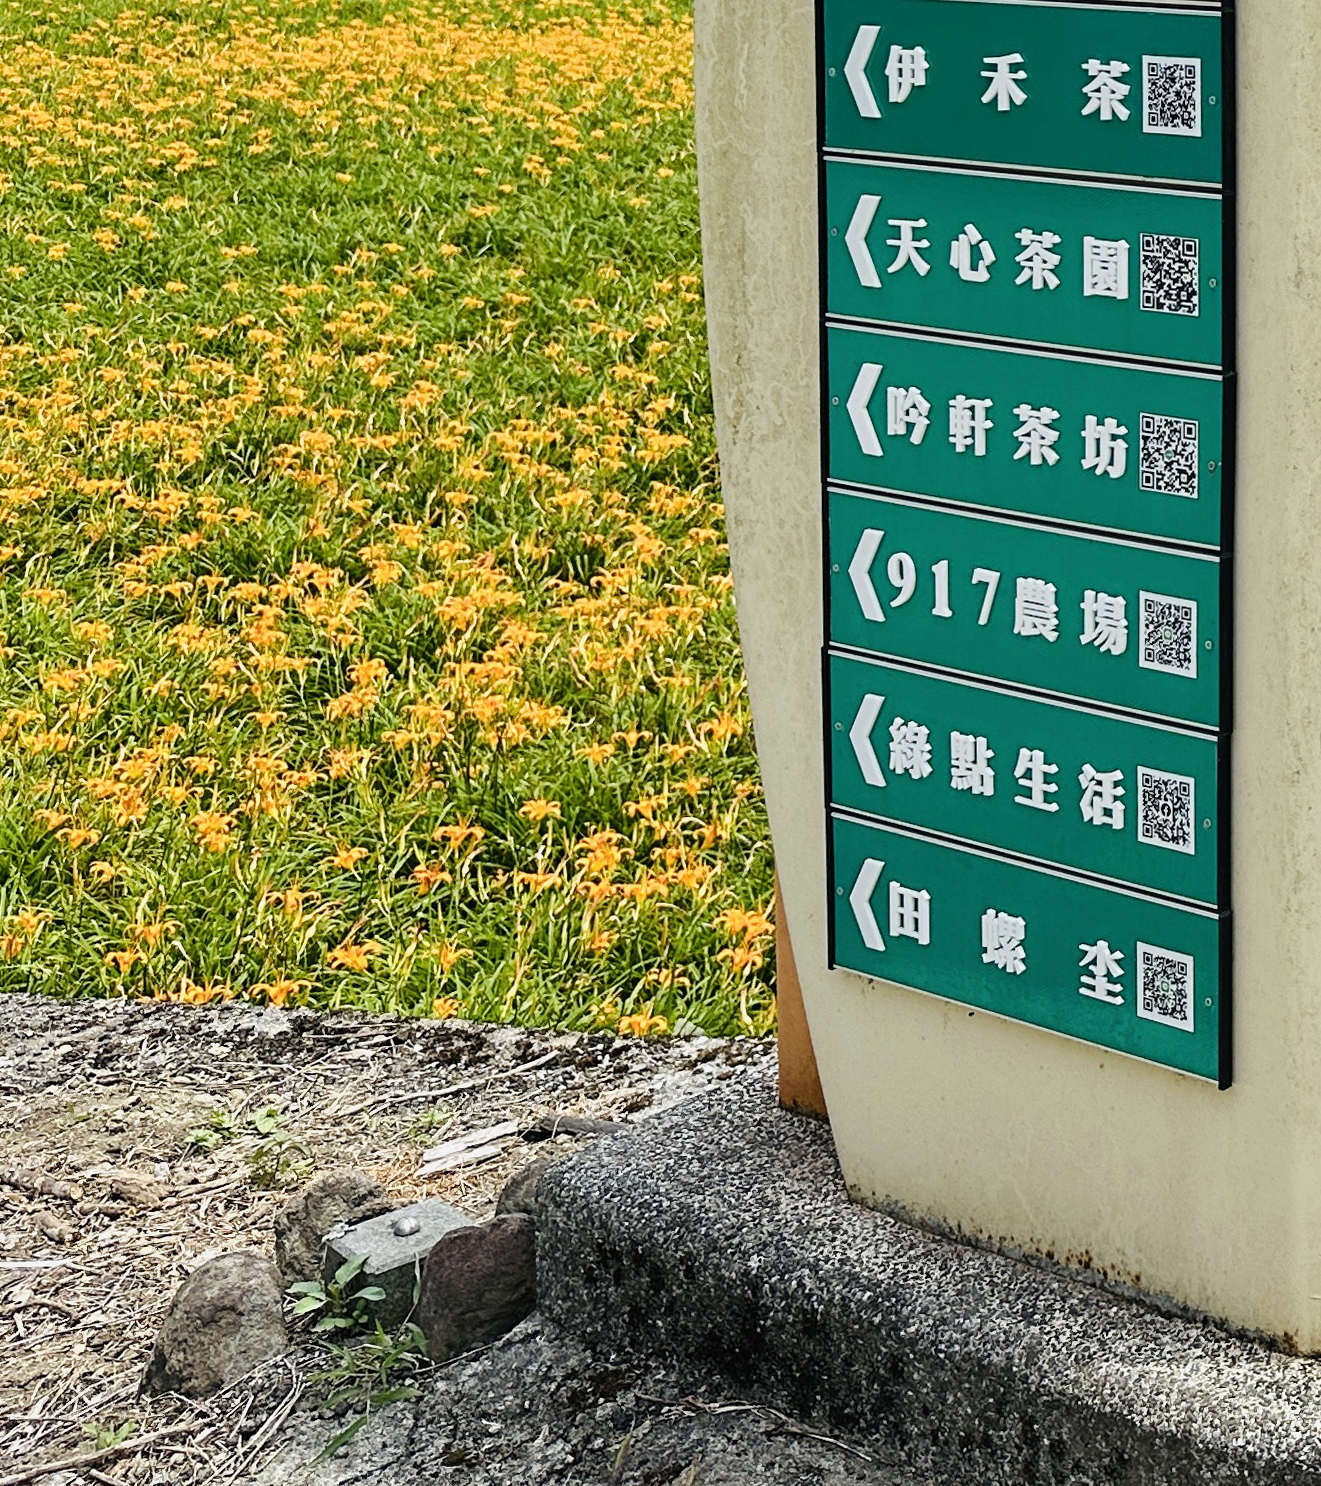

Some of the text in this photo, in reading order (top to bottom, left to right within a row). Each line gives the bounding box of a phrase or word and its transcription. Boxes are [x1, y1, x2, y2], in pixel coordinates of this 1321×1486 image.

[885, 45, 1131, 121] 伊禾茶
[886, 218, 1130, 300] 天心茶園
[887, 386, 1128, 478] 吟軒茶坊
[887, 552, 1128, 655] 917農場
[888, 717, 1126, 830] 綠點生活
